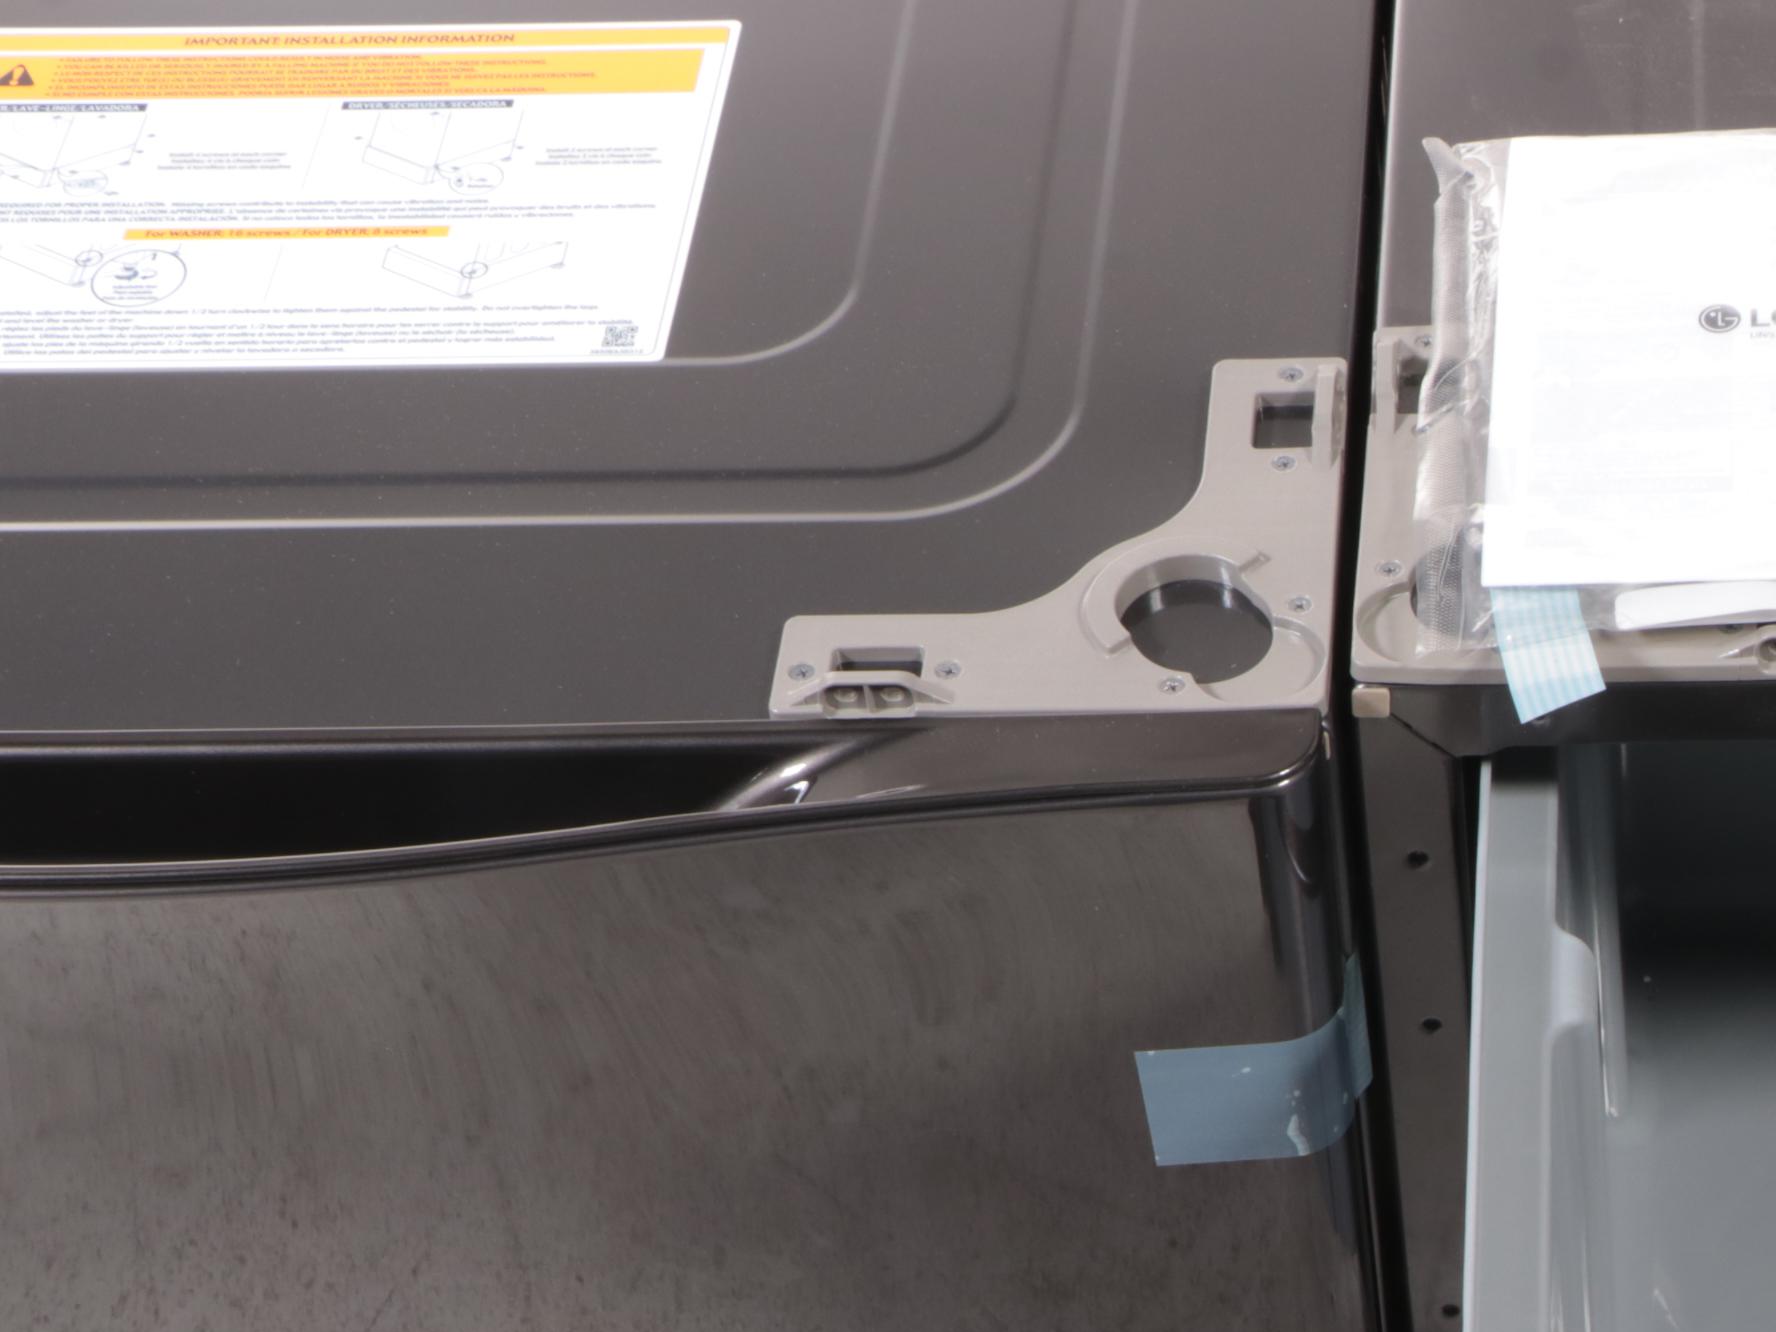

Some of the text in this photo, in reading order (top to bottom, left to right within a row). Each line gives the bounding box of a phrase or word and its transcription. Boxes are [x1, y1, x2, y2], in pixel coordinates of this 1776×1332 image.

[185, 34, 514, 46] IMPORTANT INSTALLATION INFORMATION
